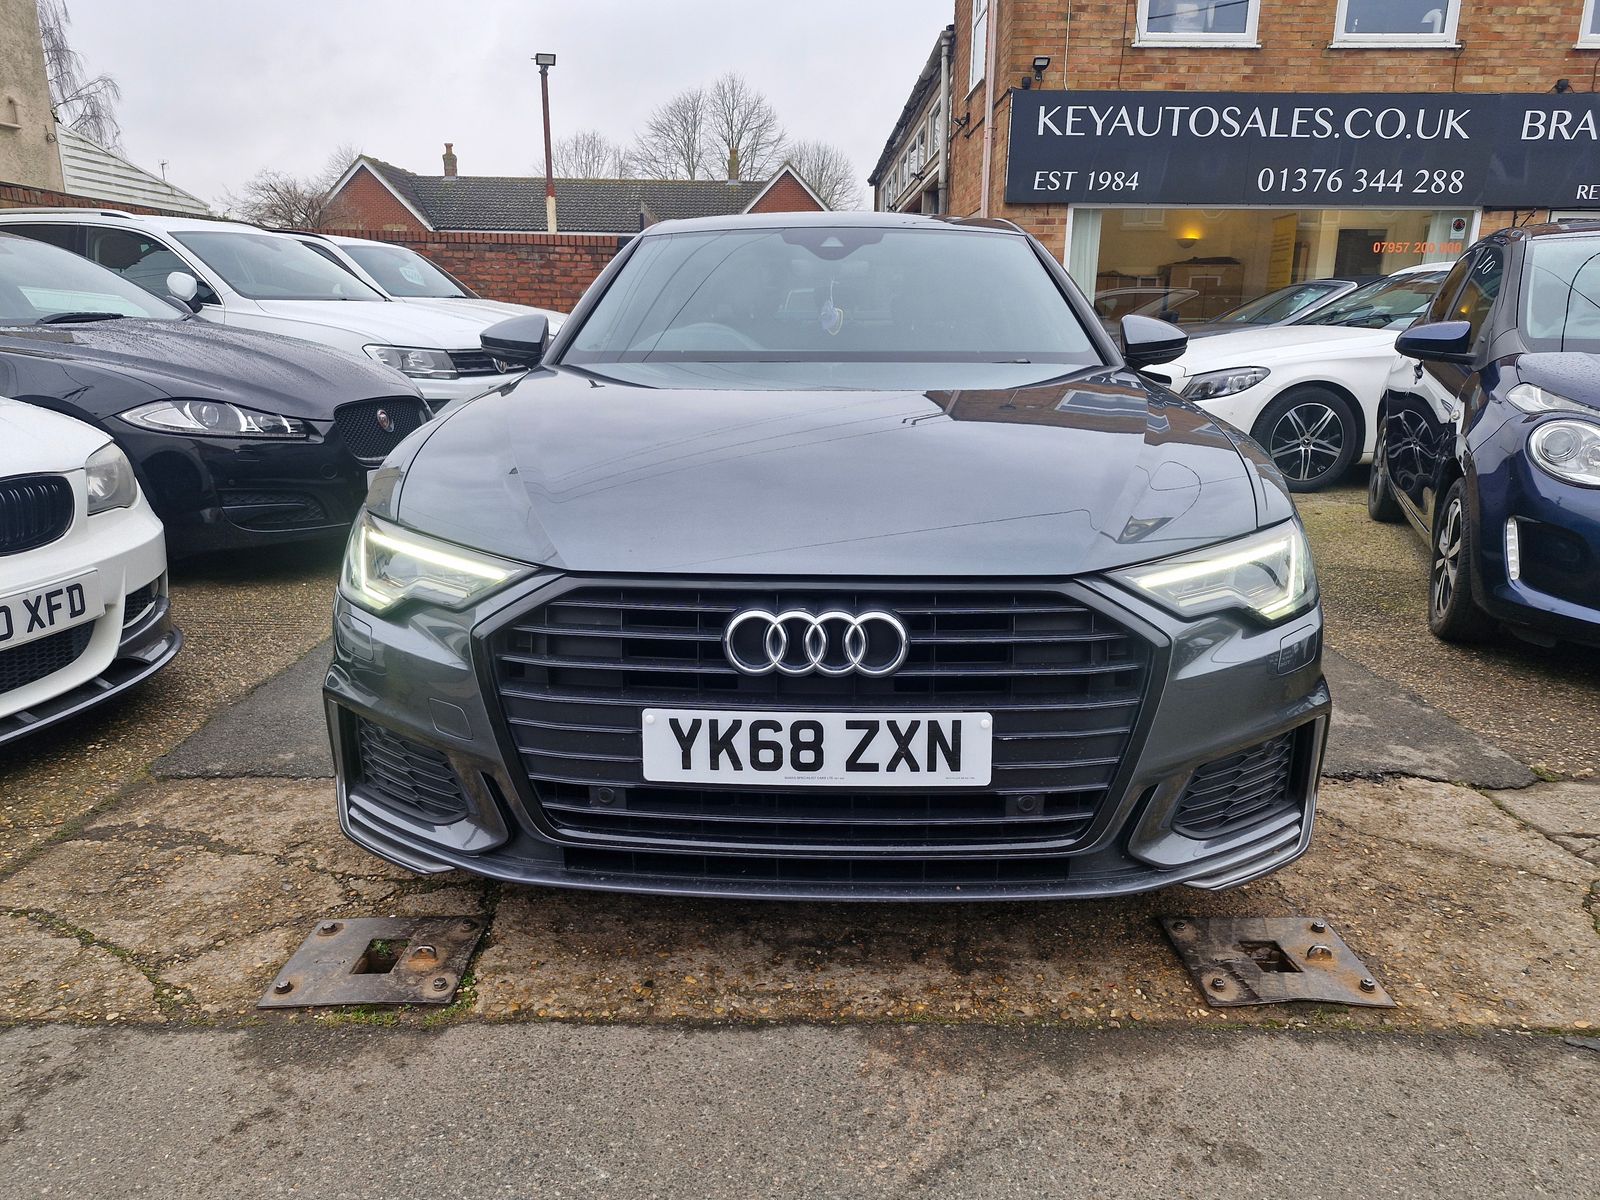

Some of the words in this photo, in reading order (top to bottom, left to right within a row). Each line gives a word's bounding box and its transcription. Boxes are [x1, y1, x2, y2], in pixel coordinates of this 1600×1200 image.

[1037, 105, 1471, 140] KEYAUTOSALES.CO.UK
[1520, 109, 1598, 141] BRA
[1033, 170, 1079, 191] EST
[1087, 170, 1140, 191] 1984
[1257, 167, 1344, 193] 01376
[1351, 168, 1404, 193] 344
[1411, 169, 1466, 194] 288
[1576, 184, 1600, 200] RE
[1372, 241, 1411, 254] 07957
[22, 582, 86, 634] XFD
[668, 717, 825, 773] YK68
[844, 719, 963, 774] ZXN
